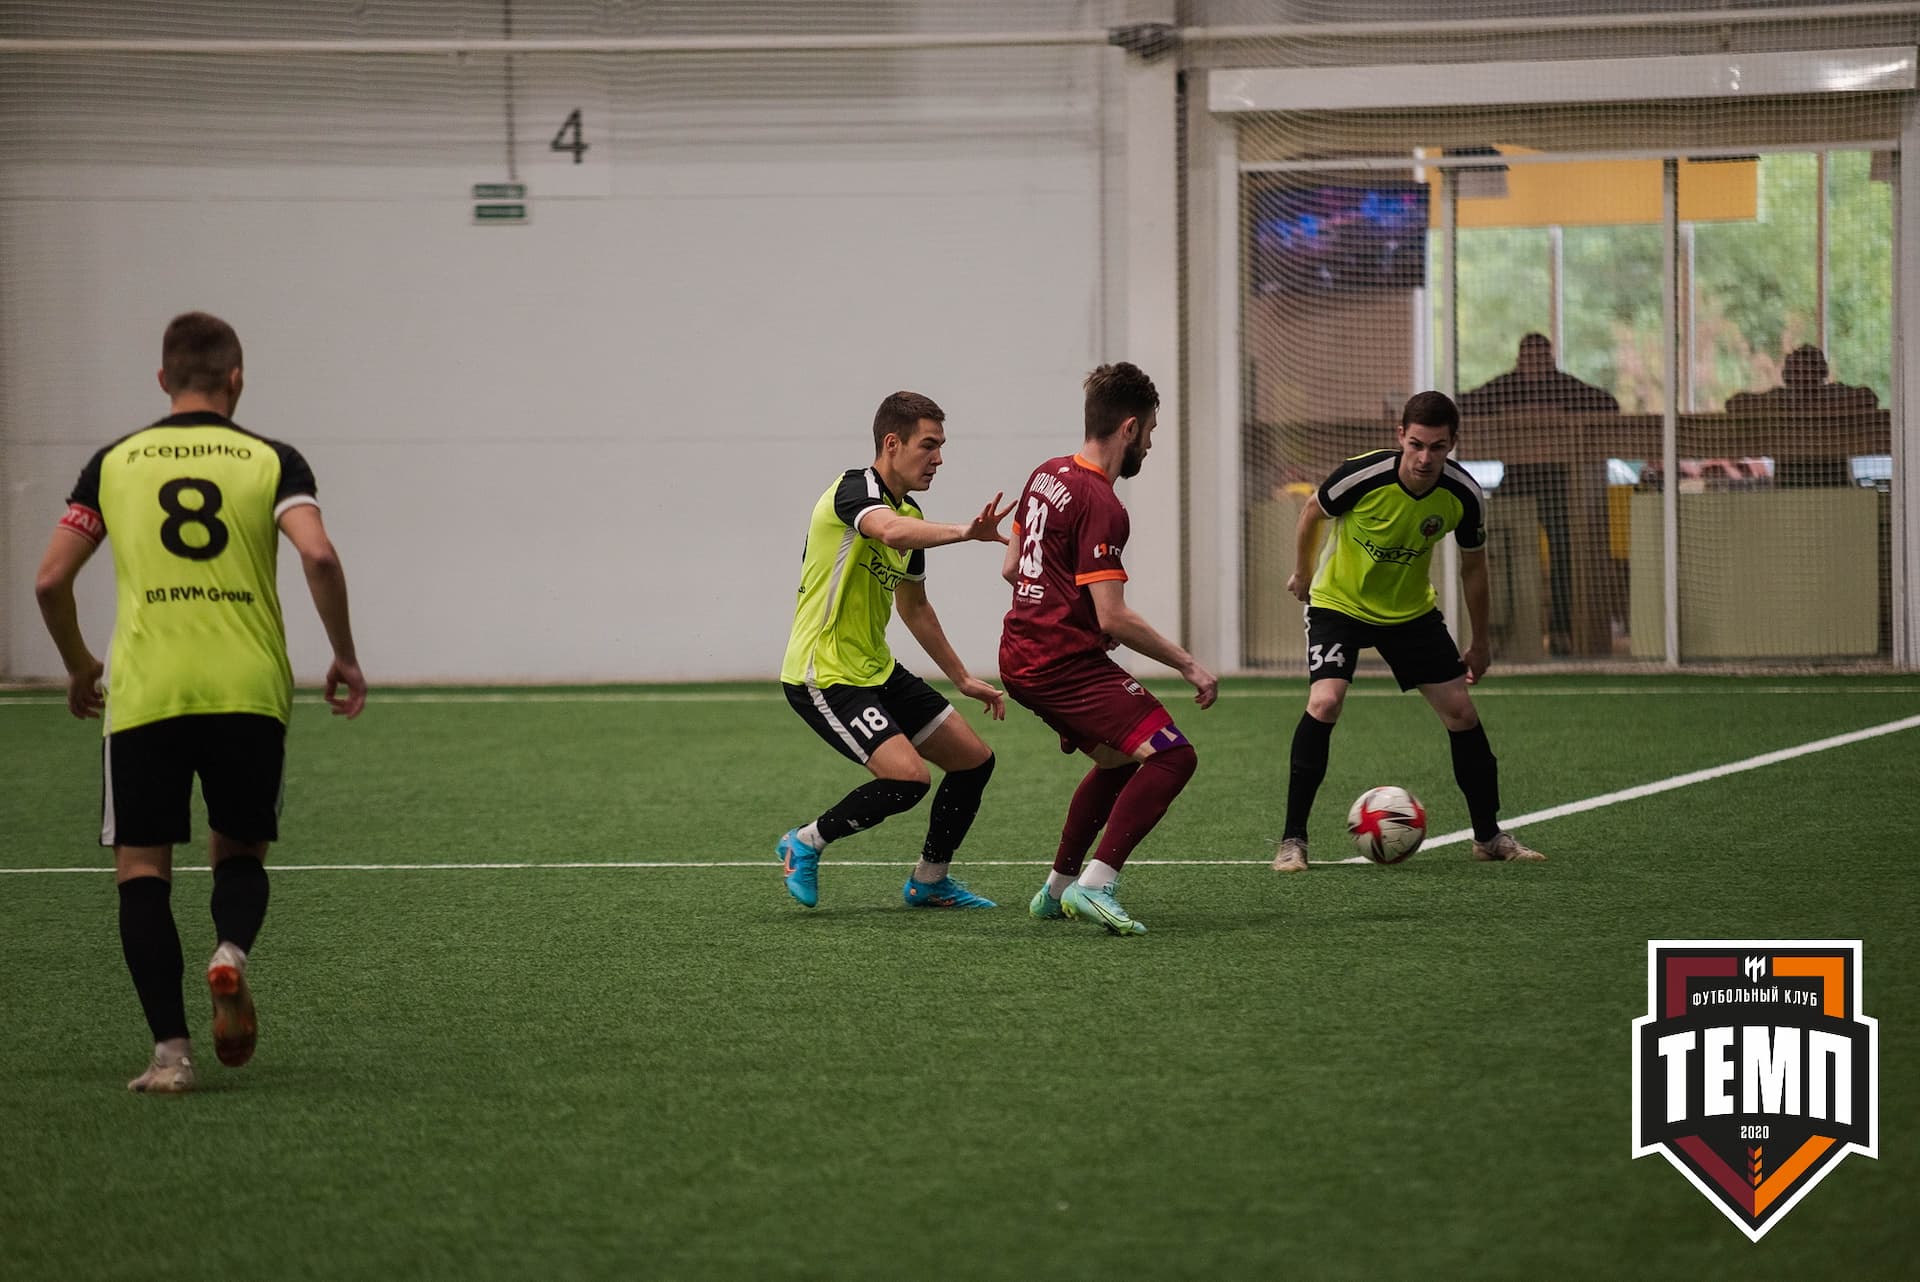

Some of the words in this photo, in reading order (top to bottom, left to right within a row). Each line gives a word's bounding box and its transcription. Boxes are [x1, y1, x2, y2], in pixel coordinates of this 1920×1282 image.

[549, 107, 590, 165] 4
[143, 444, 252, 461] сервико
[158, 477, 229, 562] 8
[169, 586, 206, 602] RVM
[207, 587, 255, 605] Group
[1309, 643, 1345, 672] 34
[850, 707, 889, 740] 18
